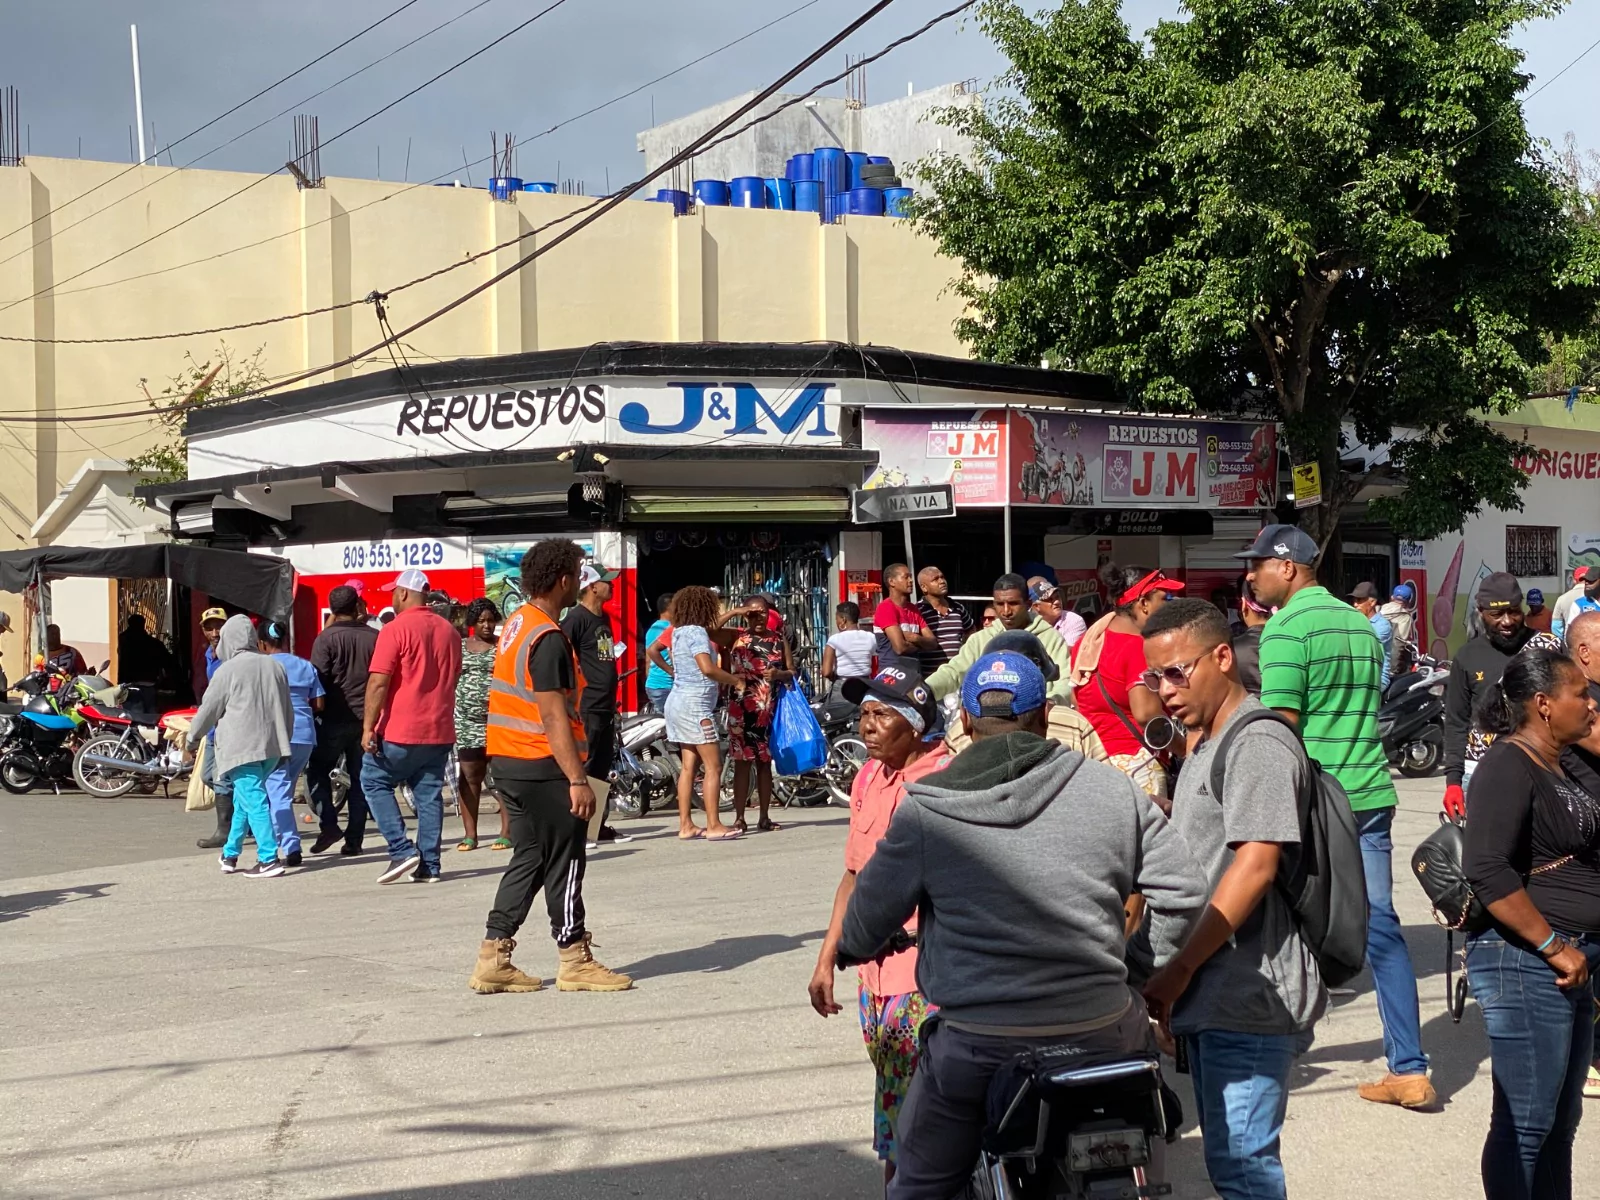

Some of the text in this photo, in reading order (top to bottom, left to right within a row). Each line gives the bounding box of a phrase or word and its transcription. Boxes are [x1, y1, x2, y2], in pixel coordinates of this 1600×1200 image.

[396, 381, 836, 437] REPUESTOS J&M
[931, 421, 998, 430] REPUESTOS
[1108, 424, 1198, 445] REPUESTOS
[948, 433, 997, 455] JM
[1219, 442, 1253, 450] 809-553-1229
[1132, 451, 1198, 496] J&M
[913, 495, 938, 509] VIA
[1118, 511, 1159, 523] BOLO
